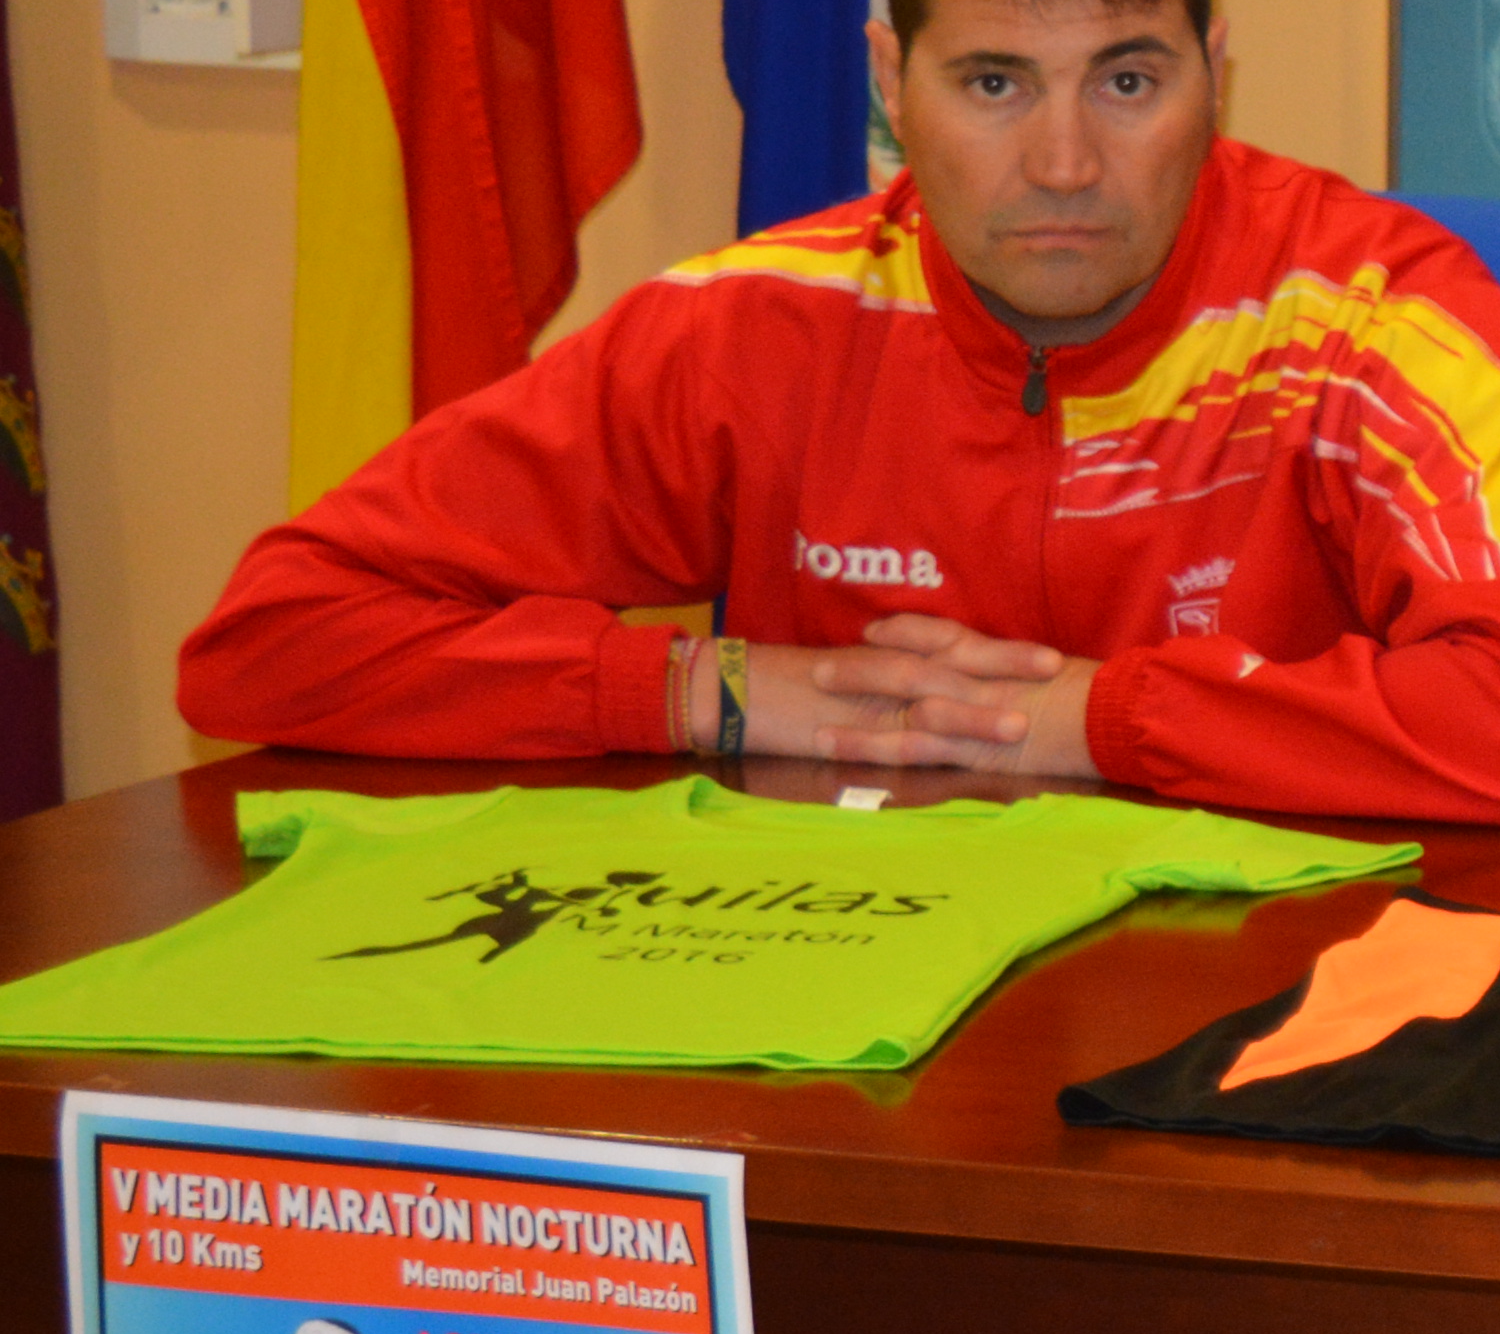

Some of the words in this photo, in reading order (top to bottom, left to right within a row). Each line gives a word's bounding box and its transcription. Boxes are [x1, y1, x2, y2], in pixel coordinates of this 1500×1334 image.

[600, 947, 755, 965] 2016
[111, 1167, 138, 1214] V
[146, 1173, 271, 1228] MEDIA
[279, 1181, 472, 1244] MARATÓN
[481, 1202, 695, 1267] NOCTURNA
[120, 1232, 139, 1266] y
[147, 1228, 186, 1262] 10
[191, 1234, 263, 1273] Kms
[402, 1258, 526, 1297] Memorial
[531, 1271, 592, 1304] Juan
[597, 1275, 699, 1315] Palazón
